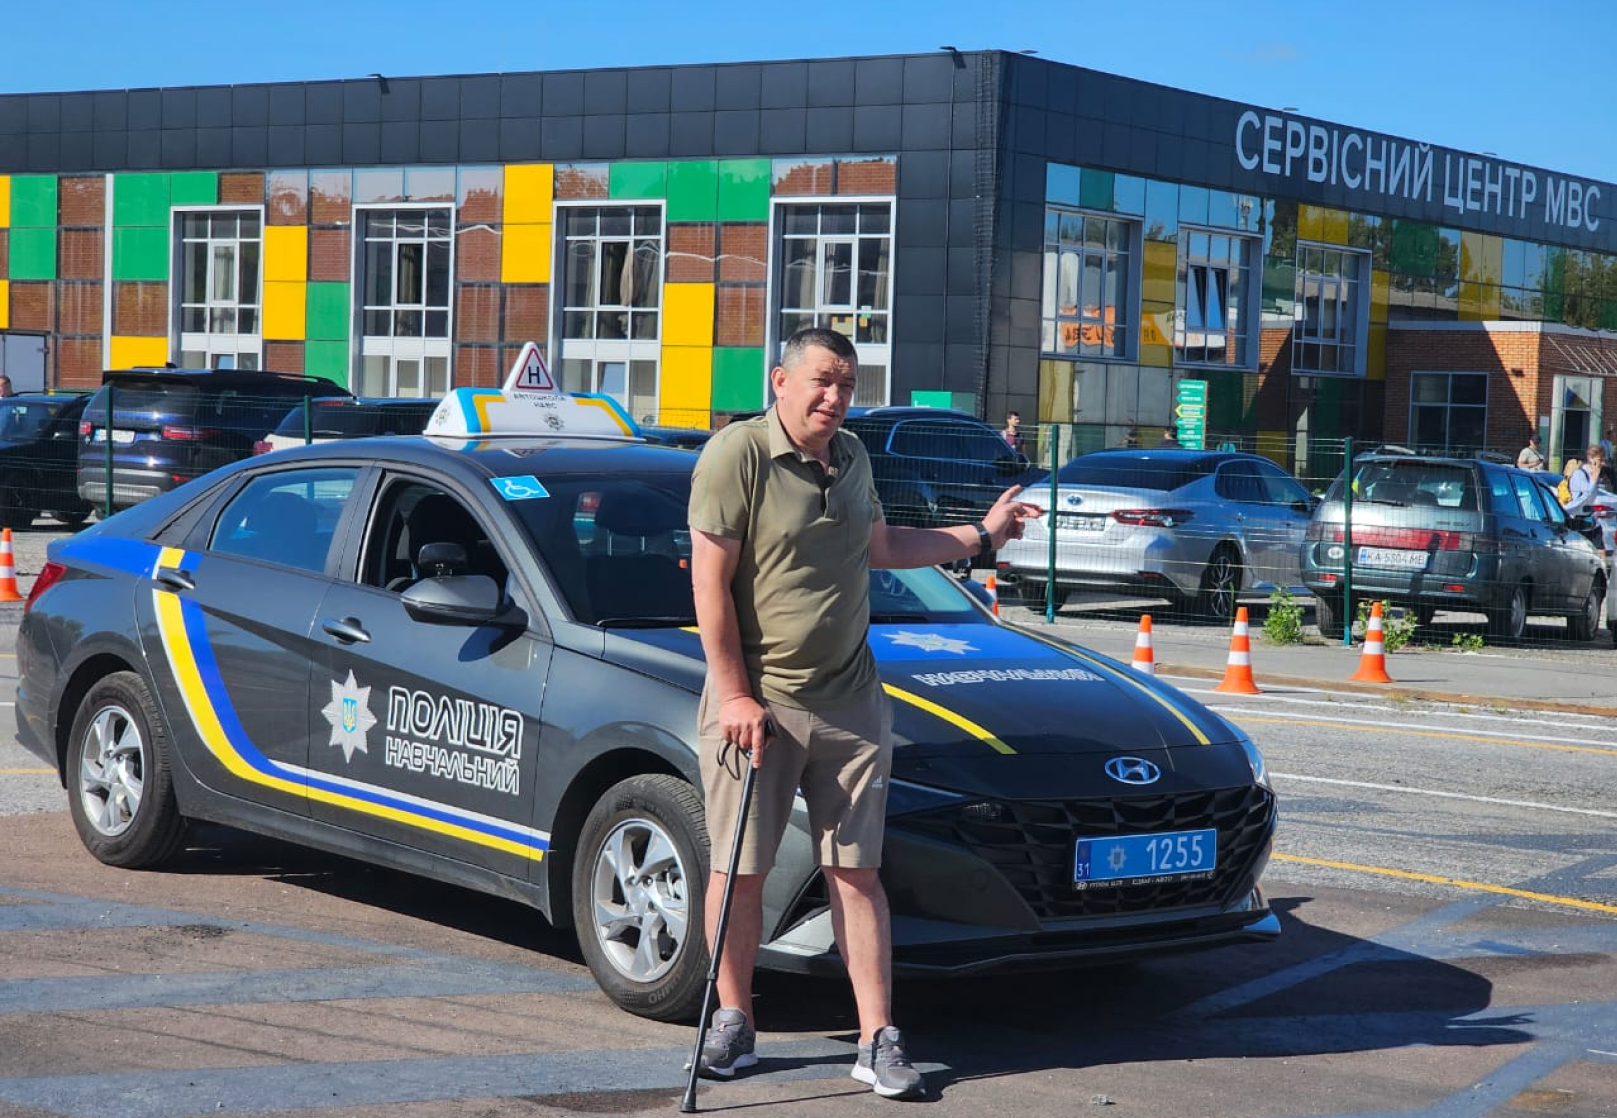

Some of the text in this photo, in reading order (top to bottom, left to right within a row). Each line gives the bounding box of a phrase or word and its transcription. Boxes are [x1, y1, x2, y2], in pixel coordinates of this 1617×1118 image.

[1235, 110, 1600, 232] СЕРВІСНИЙ ЦЕНТР МВС
[528, 366, 540, 383] Н
[387, 685, 524, 759] ПОЛІЦІЯ
[385, 735, 520, 796] НАВЧАЛЬНИЙ
[1077, 863, 1090, 877] 31
[1146, 835, 1204, 871] 1255
